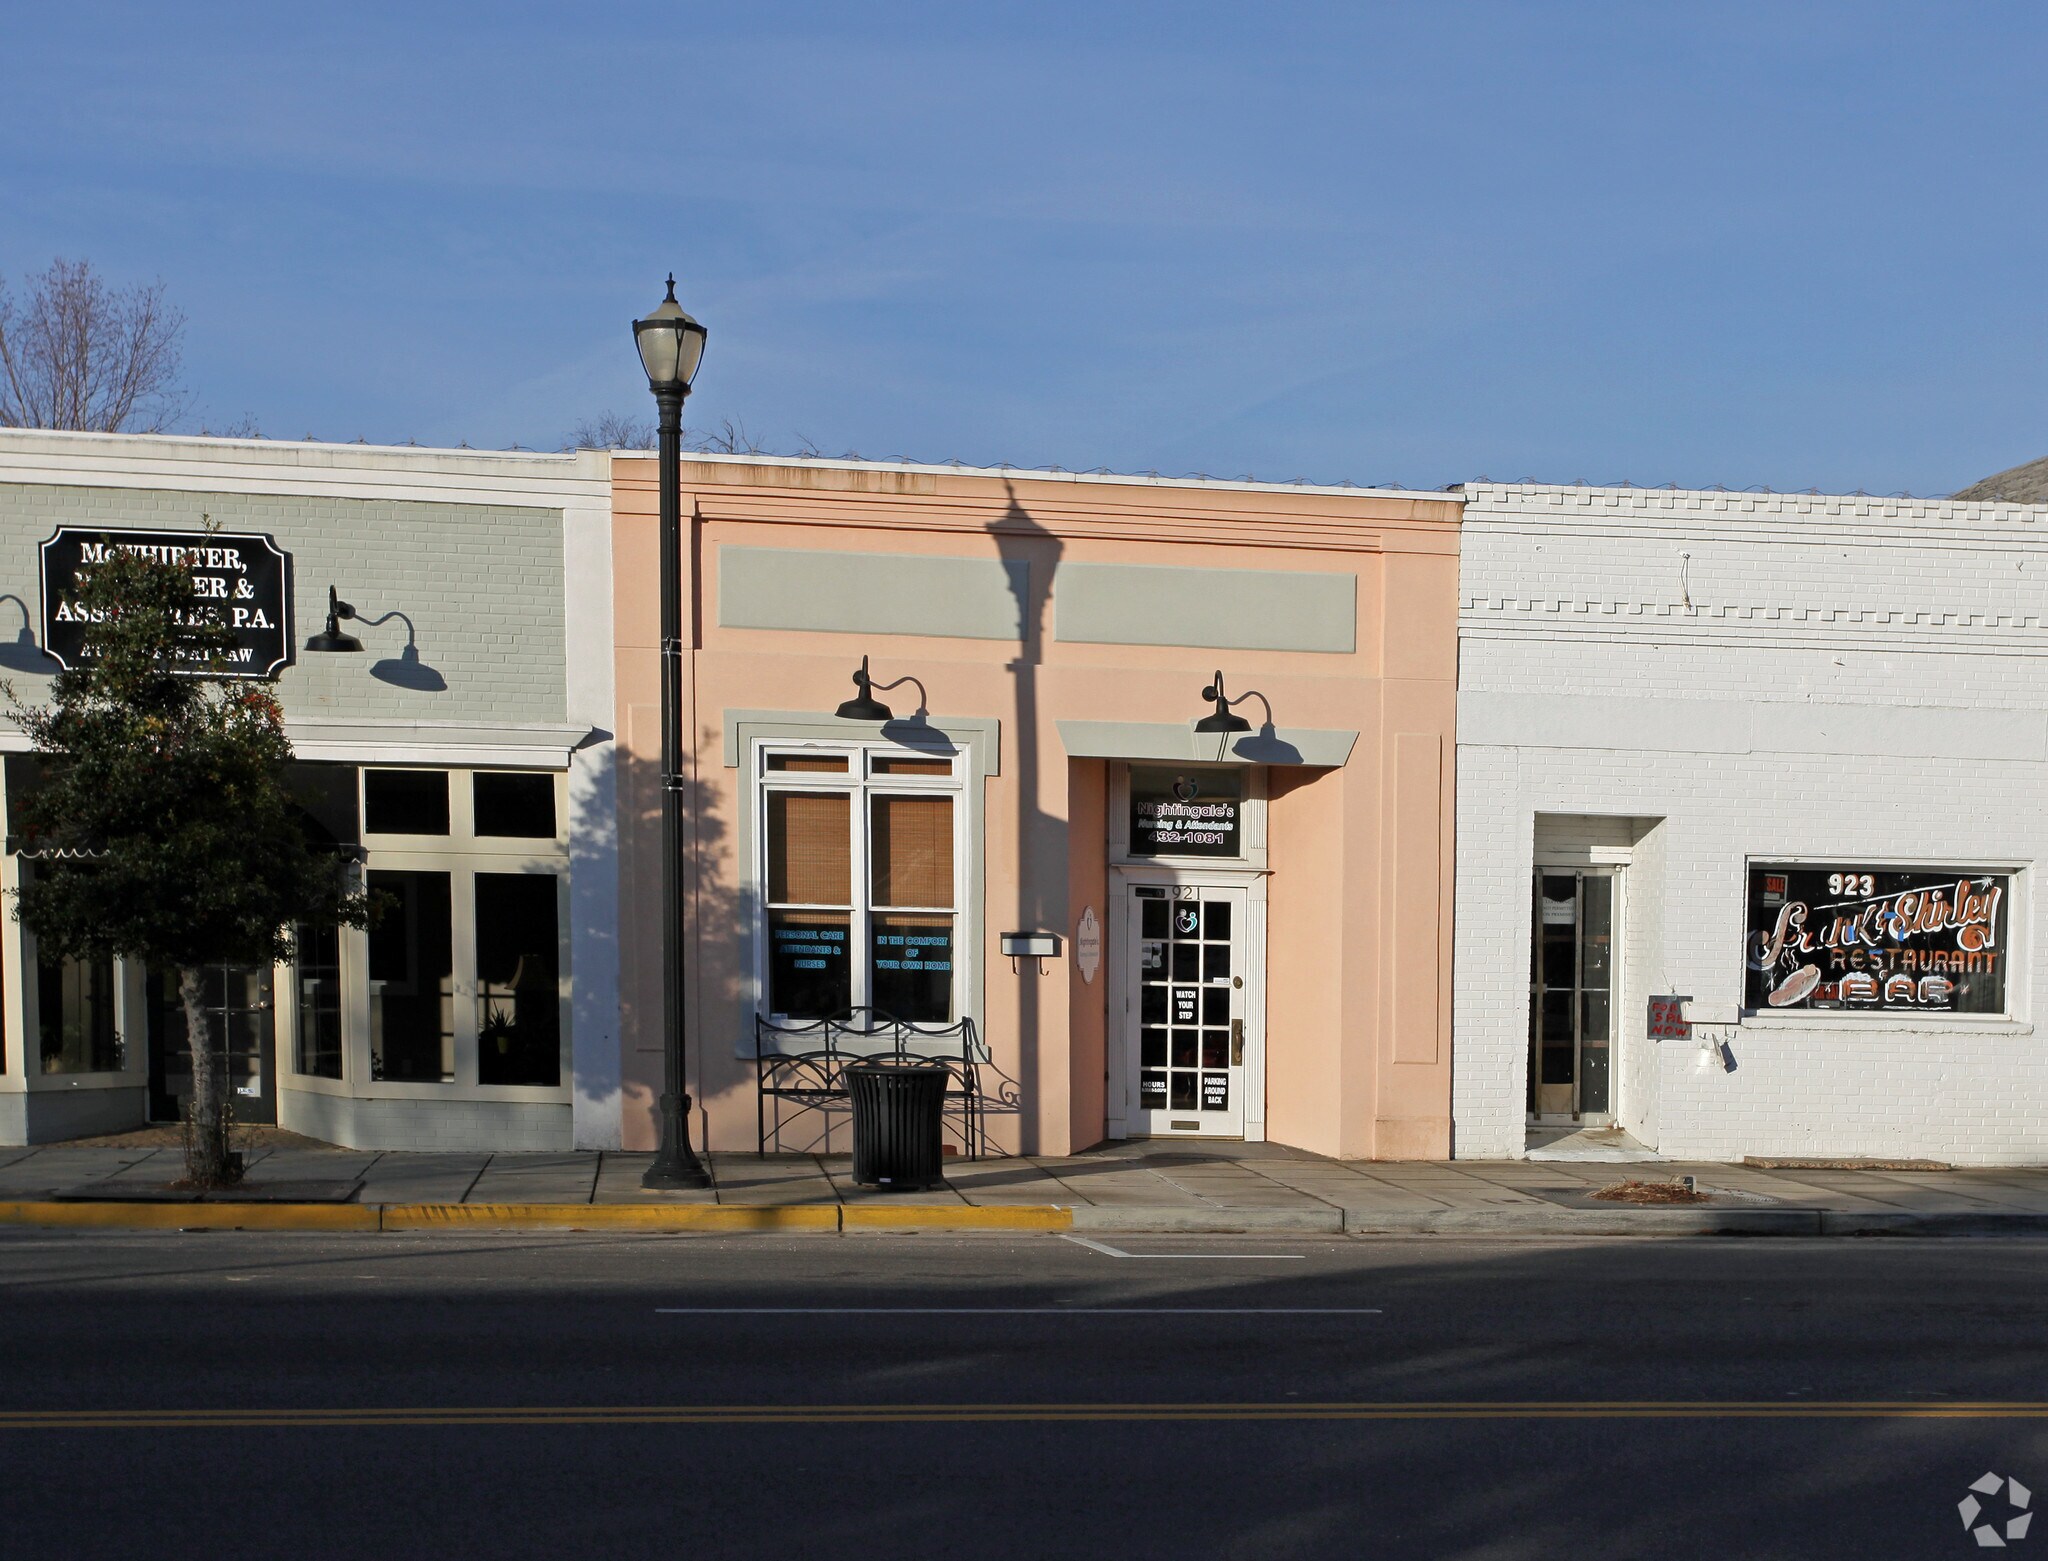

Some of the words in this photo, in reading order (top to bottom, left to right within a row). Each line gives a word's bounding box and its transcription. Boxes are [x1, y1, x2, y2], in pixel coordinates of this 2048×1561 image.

[236, 578, 254, 599] &
[232, 608, 275, 629] P.A.
[1138, 803, 1234, 819] Nightingale's
[1148, 831, 1224, 844] 432-1081
[1828, 873, 1874, 897] 923
[1172, 886, 1200, 900] 921
[775, 930, 819, 940] PERSONAL
[820, 931, 844, 940] CARE
[877, 936, 887, 945] IN
[889, 936, 904, 945] THE
[905, 937, 948, 946] COMFORT
[833, 946, 841, 955] &
[905, 949, 919, 957] OF
[794, 960, 826, 969] NURSES
[876, 960, 899, 969] YOUR
[901, 961, 922, 969] OWN
[924, 962, 950, 970] HOME
[1839, 971, 1954, 1003] BAR
[1178, 1001, 1193, 1009] YOUR
[1179, 1011, 1193, 1019] STEP
[1651, 1024, 1687, 1036] NOW
[1204, 1077, 1226, 1086] PARKING
[1204, 1087, 1226, 1095] AROUND
[1208, 1096, 1222, 1104] BACK
